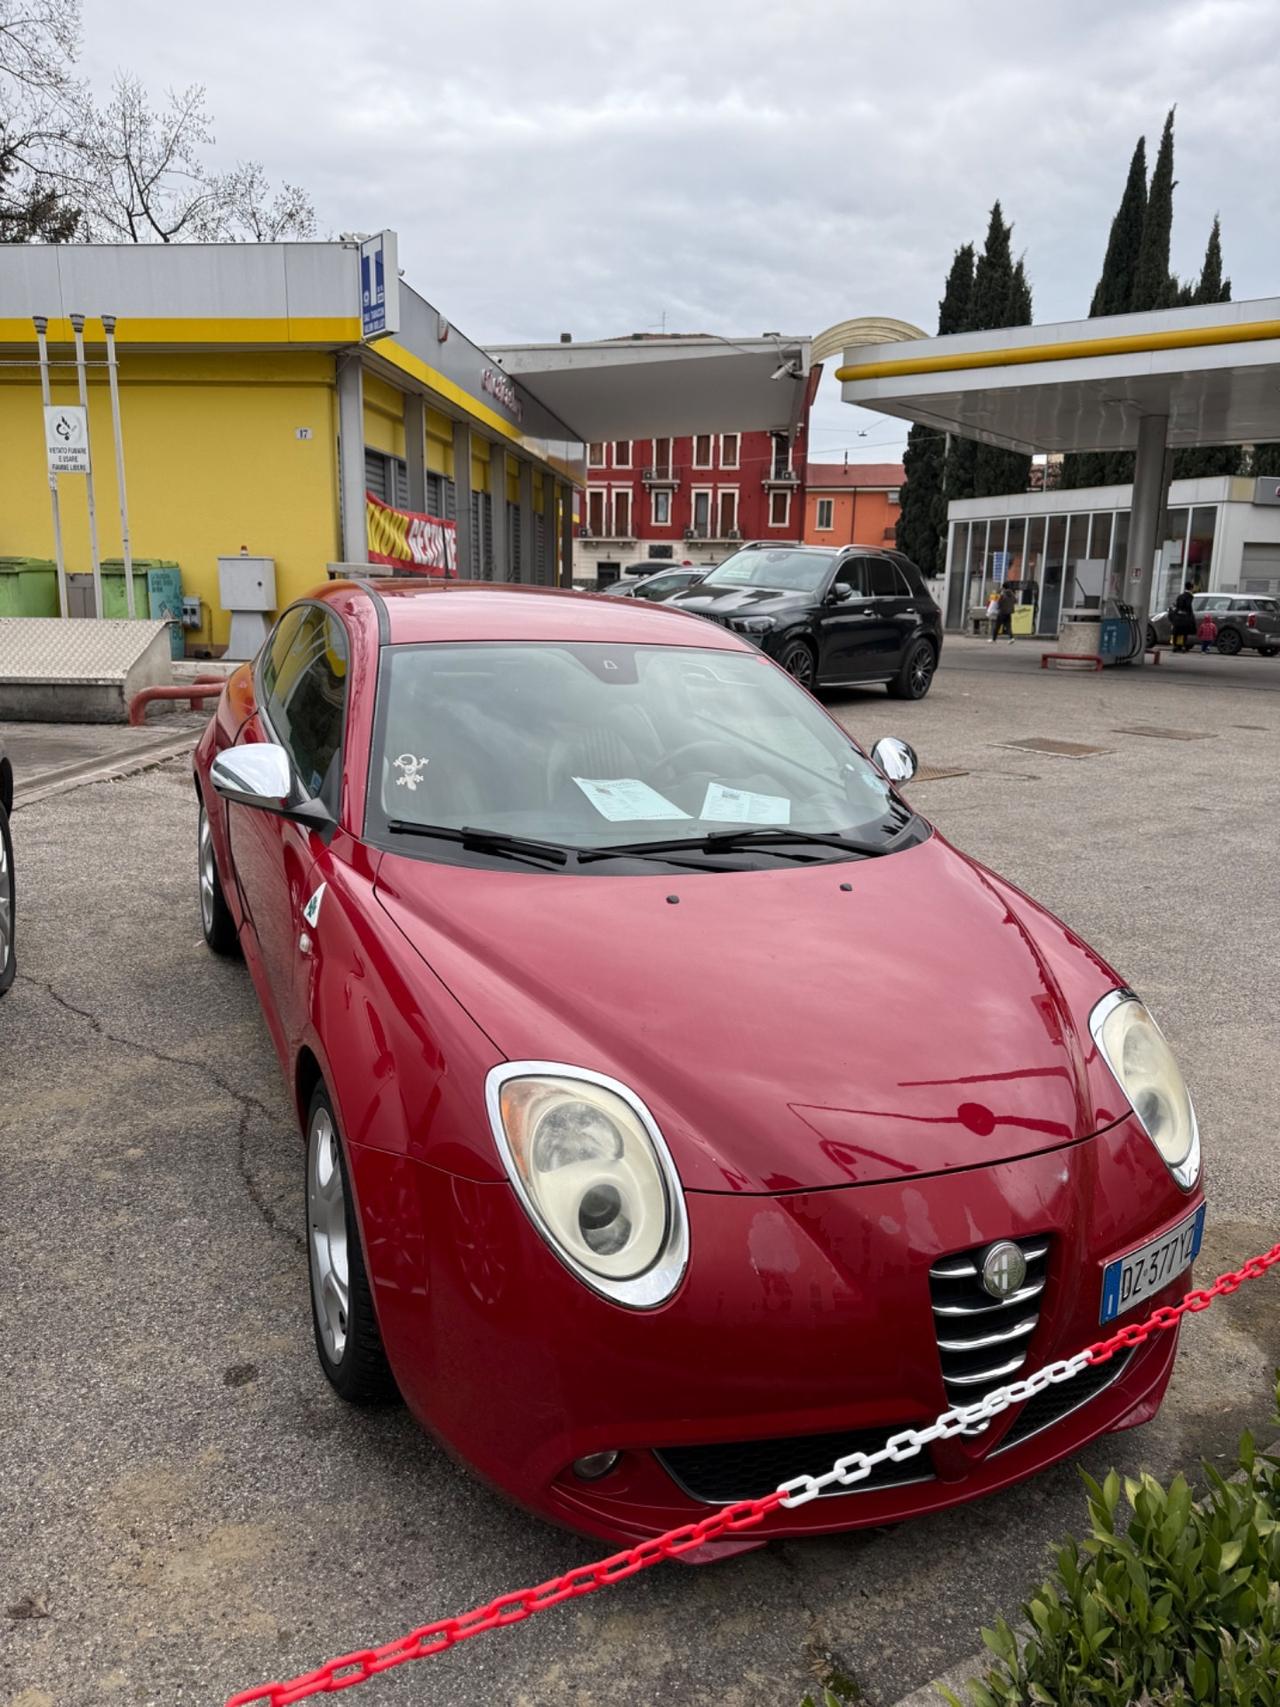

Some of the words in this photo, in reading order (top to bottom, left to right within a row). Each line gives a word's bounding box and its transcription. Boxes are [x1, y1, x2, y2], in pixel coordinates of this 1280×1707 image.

[362, 236, 382, 306] T
[300, 428, 308, 438] 17
[49, 446, 67, 455] VIETATO
[68, 447, 87, 455] FUMARE
[63, 455, 78, 463] USARE
